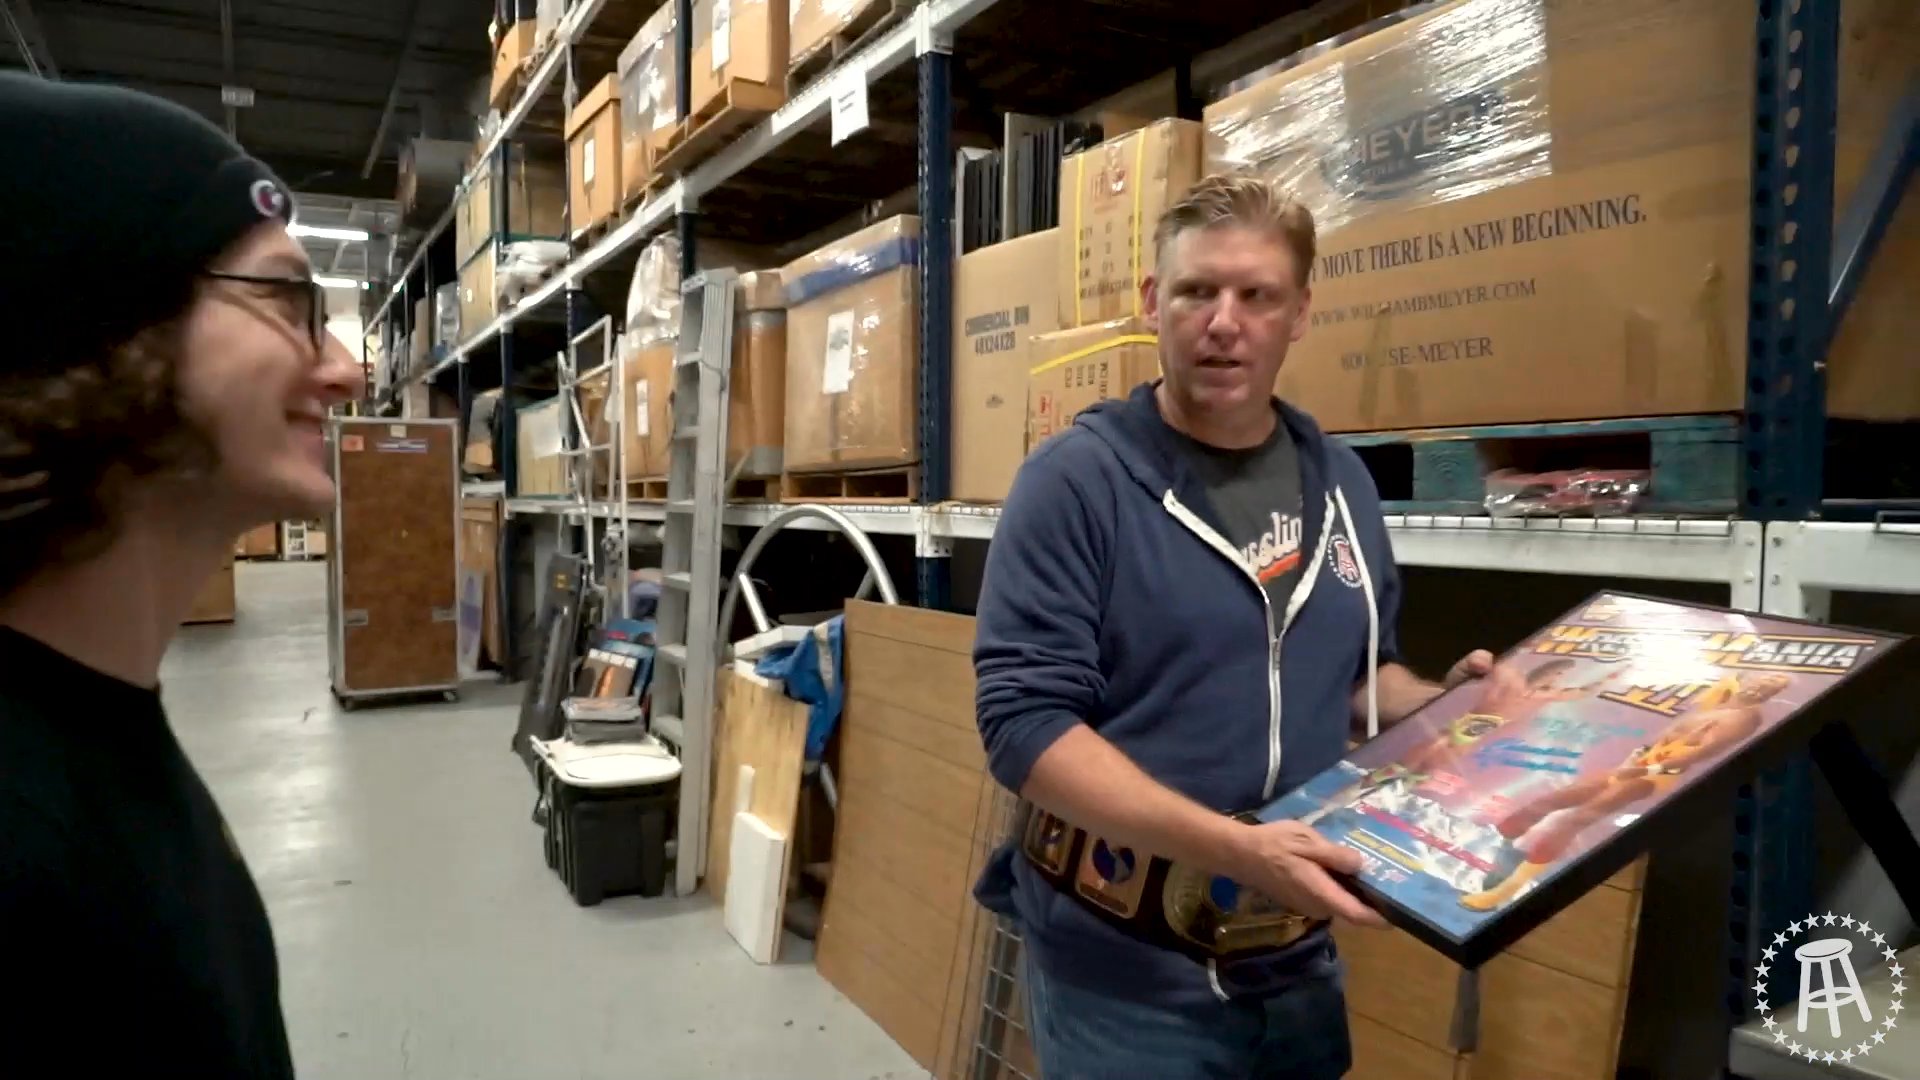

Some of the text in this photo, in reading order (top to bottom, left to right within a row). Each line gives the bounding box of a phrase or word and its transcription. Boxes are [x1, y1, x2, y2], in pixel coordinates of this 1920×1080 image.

[1322, 248, 1365, 280] MOVE
[1368, 236, 1423, 272] THERE
[1428, 231, 1445, 260] IS
[1449, 234, 1461, 257] A
[1464, 218, 1505, 251] NEW
[1512, 194, 1647, 244] BEGINNING.
